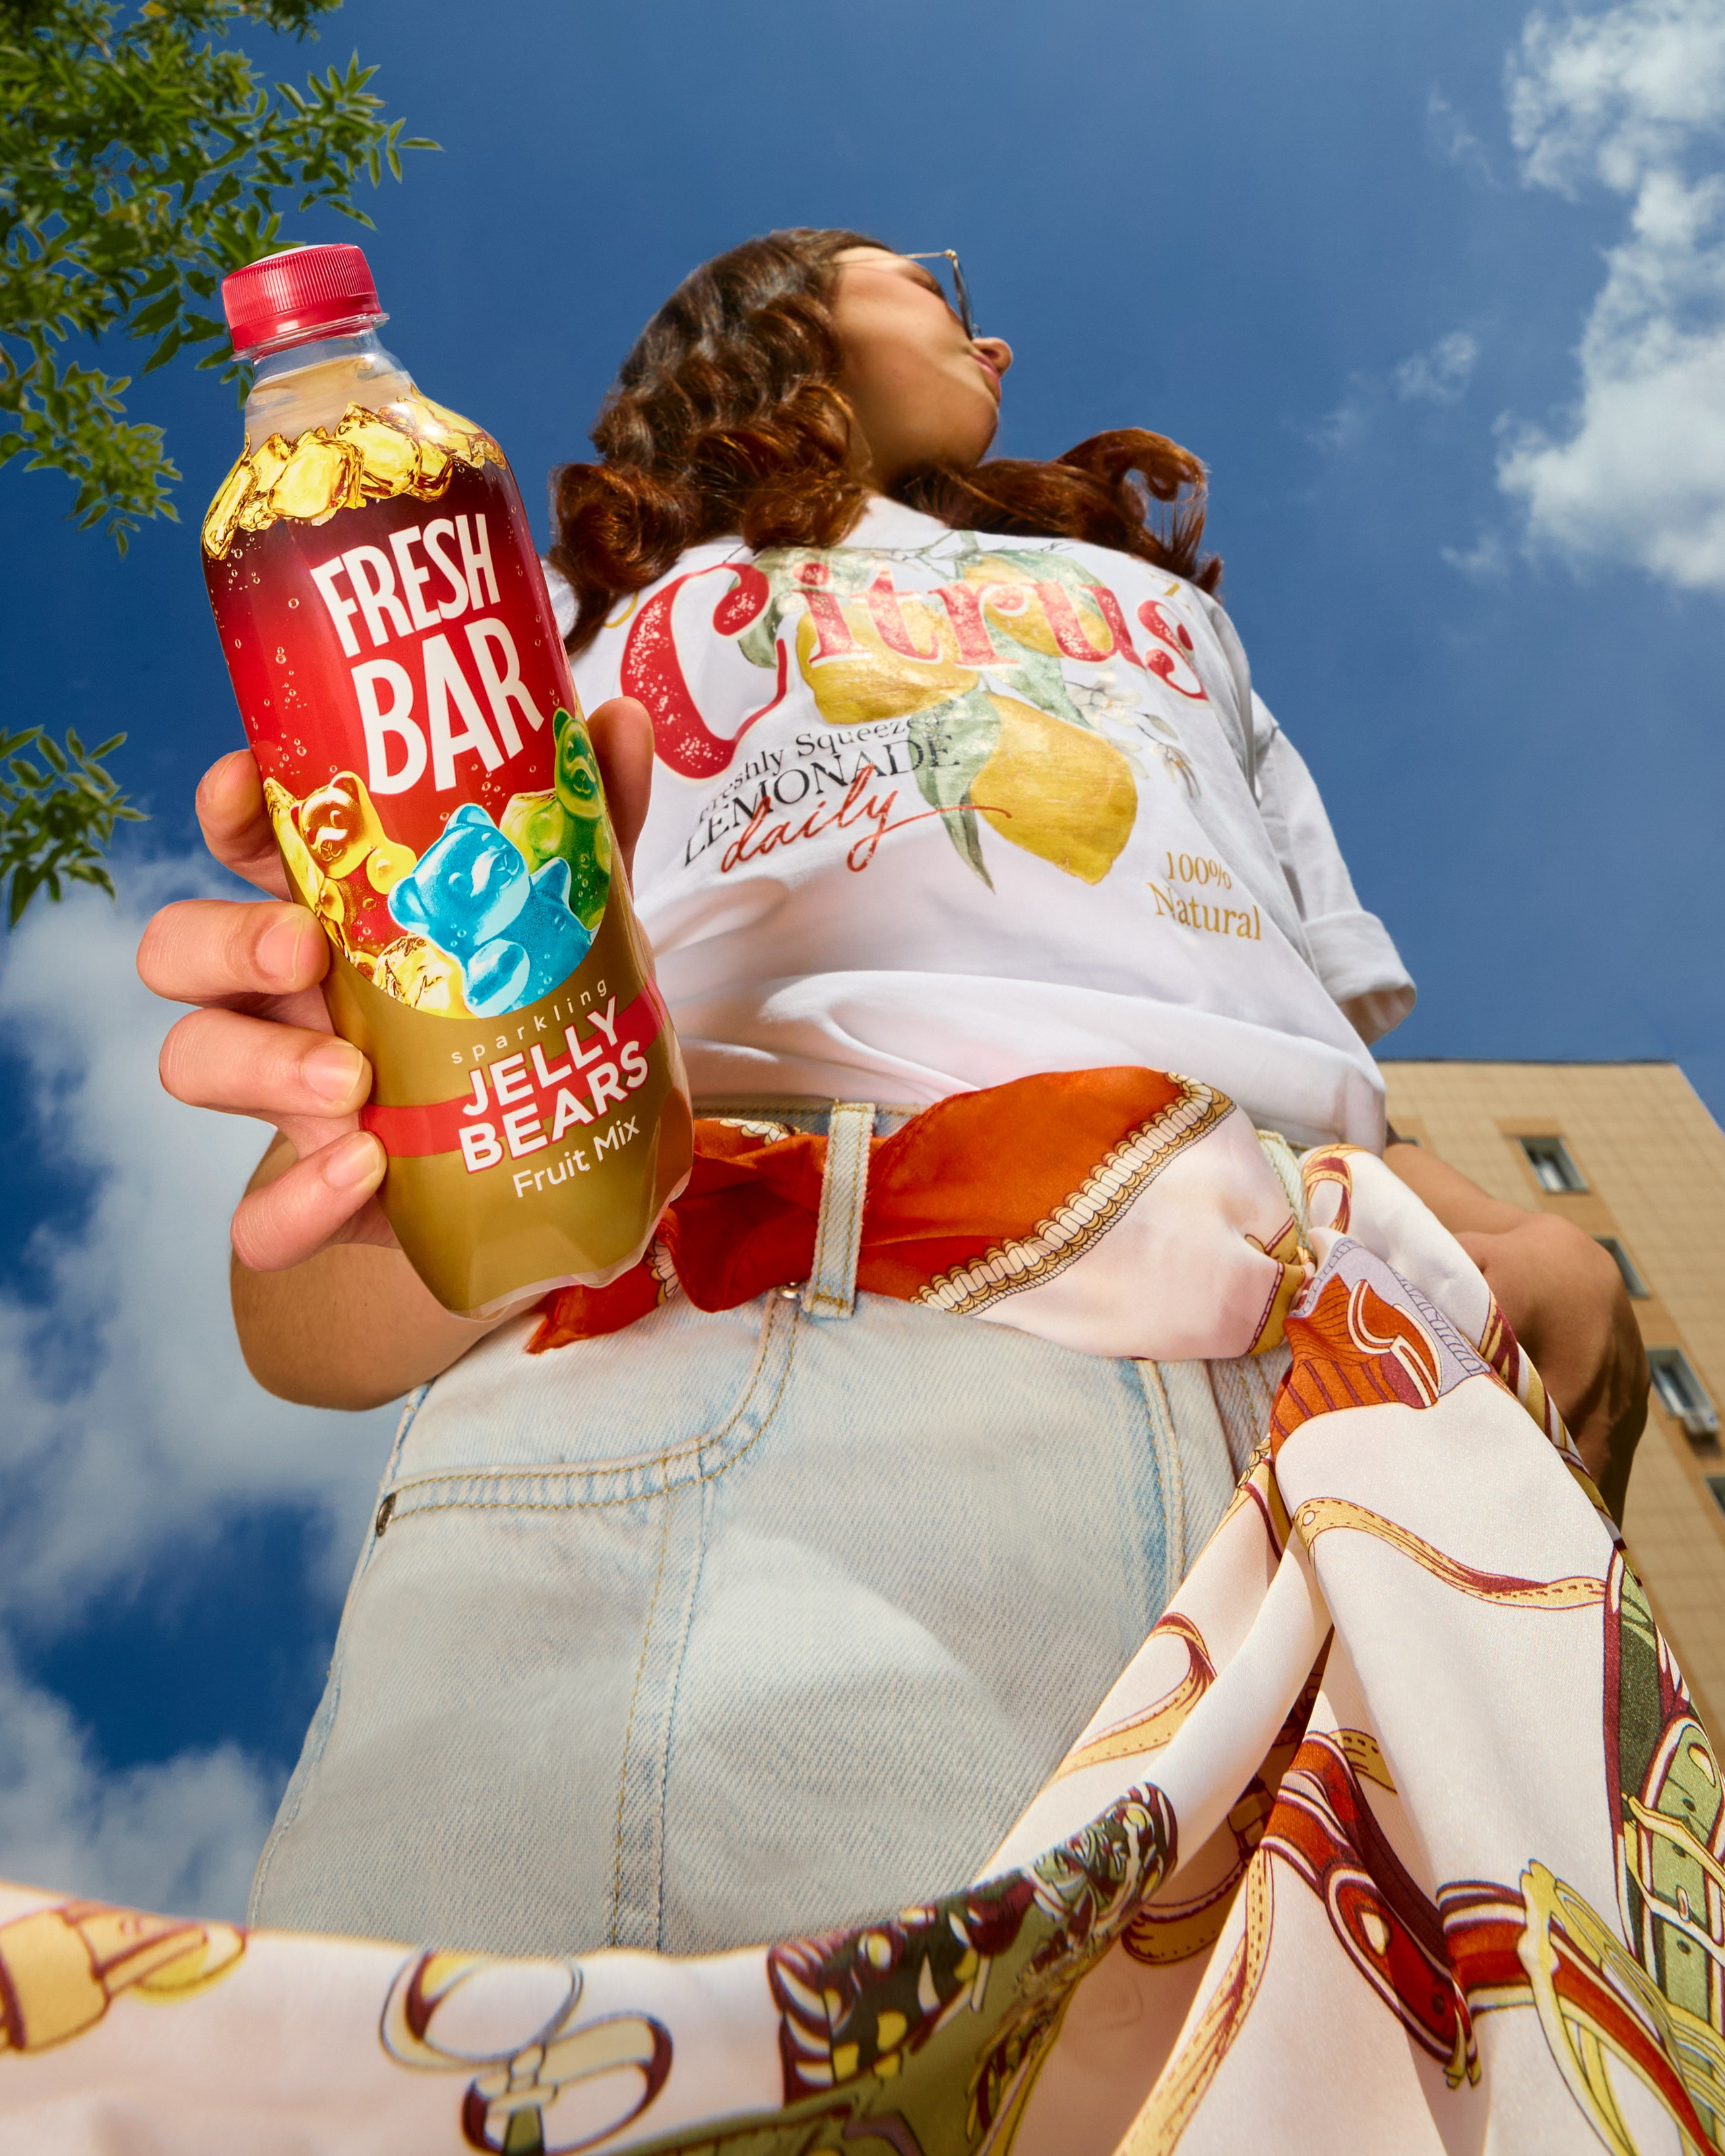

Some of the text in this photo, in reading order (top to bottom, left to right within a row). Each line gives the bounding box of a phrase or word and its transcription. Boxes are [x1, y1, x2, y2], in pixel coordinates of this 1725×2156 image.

[310, 513, 501, 658] FRESH
[350, 617, 544, 795] BAR
[619, 562, 1210, 780] Citrus
[685, 734, 960, 867] LEMONADE
[720, 763, 1013, 874] daily
[1146, 881, 1261, 941] Natural
[1166, 850, 1232, 890] 100%
[451, 978, 608, 1065] sparkling
[461, 995, 619, 1118] JELLY
[458, 1040, 649, 1173] BEARS
[512, 1116, 640, 1198] Fruit Mix
